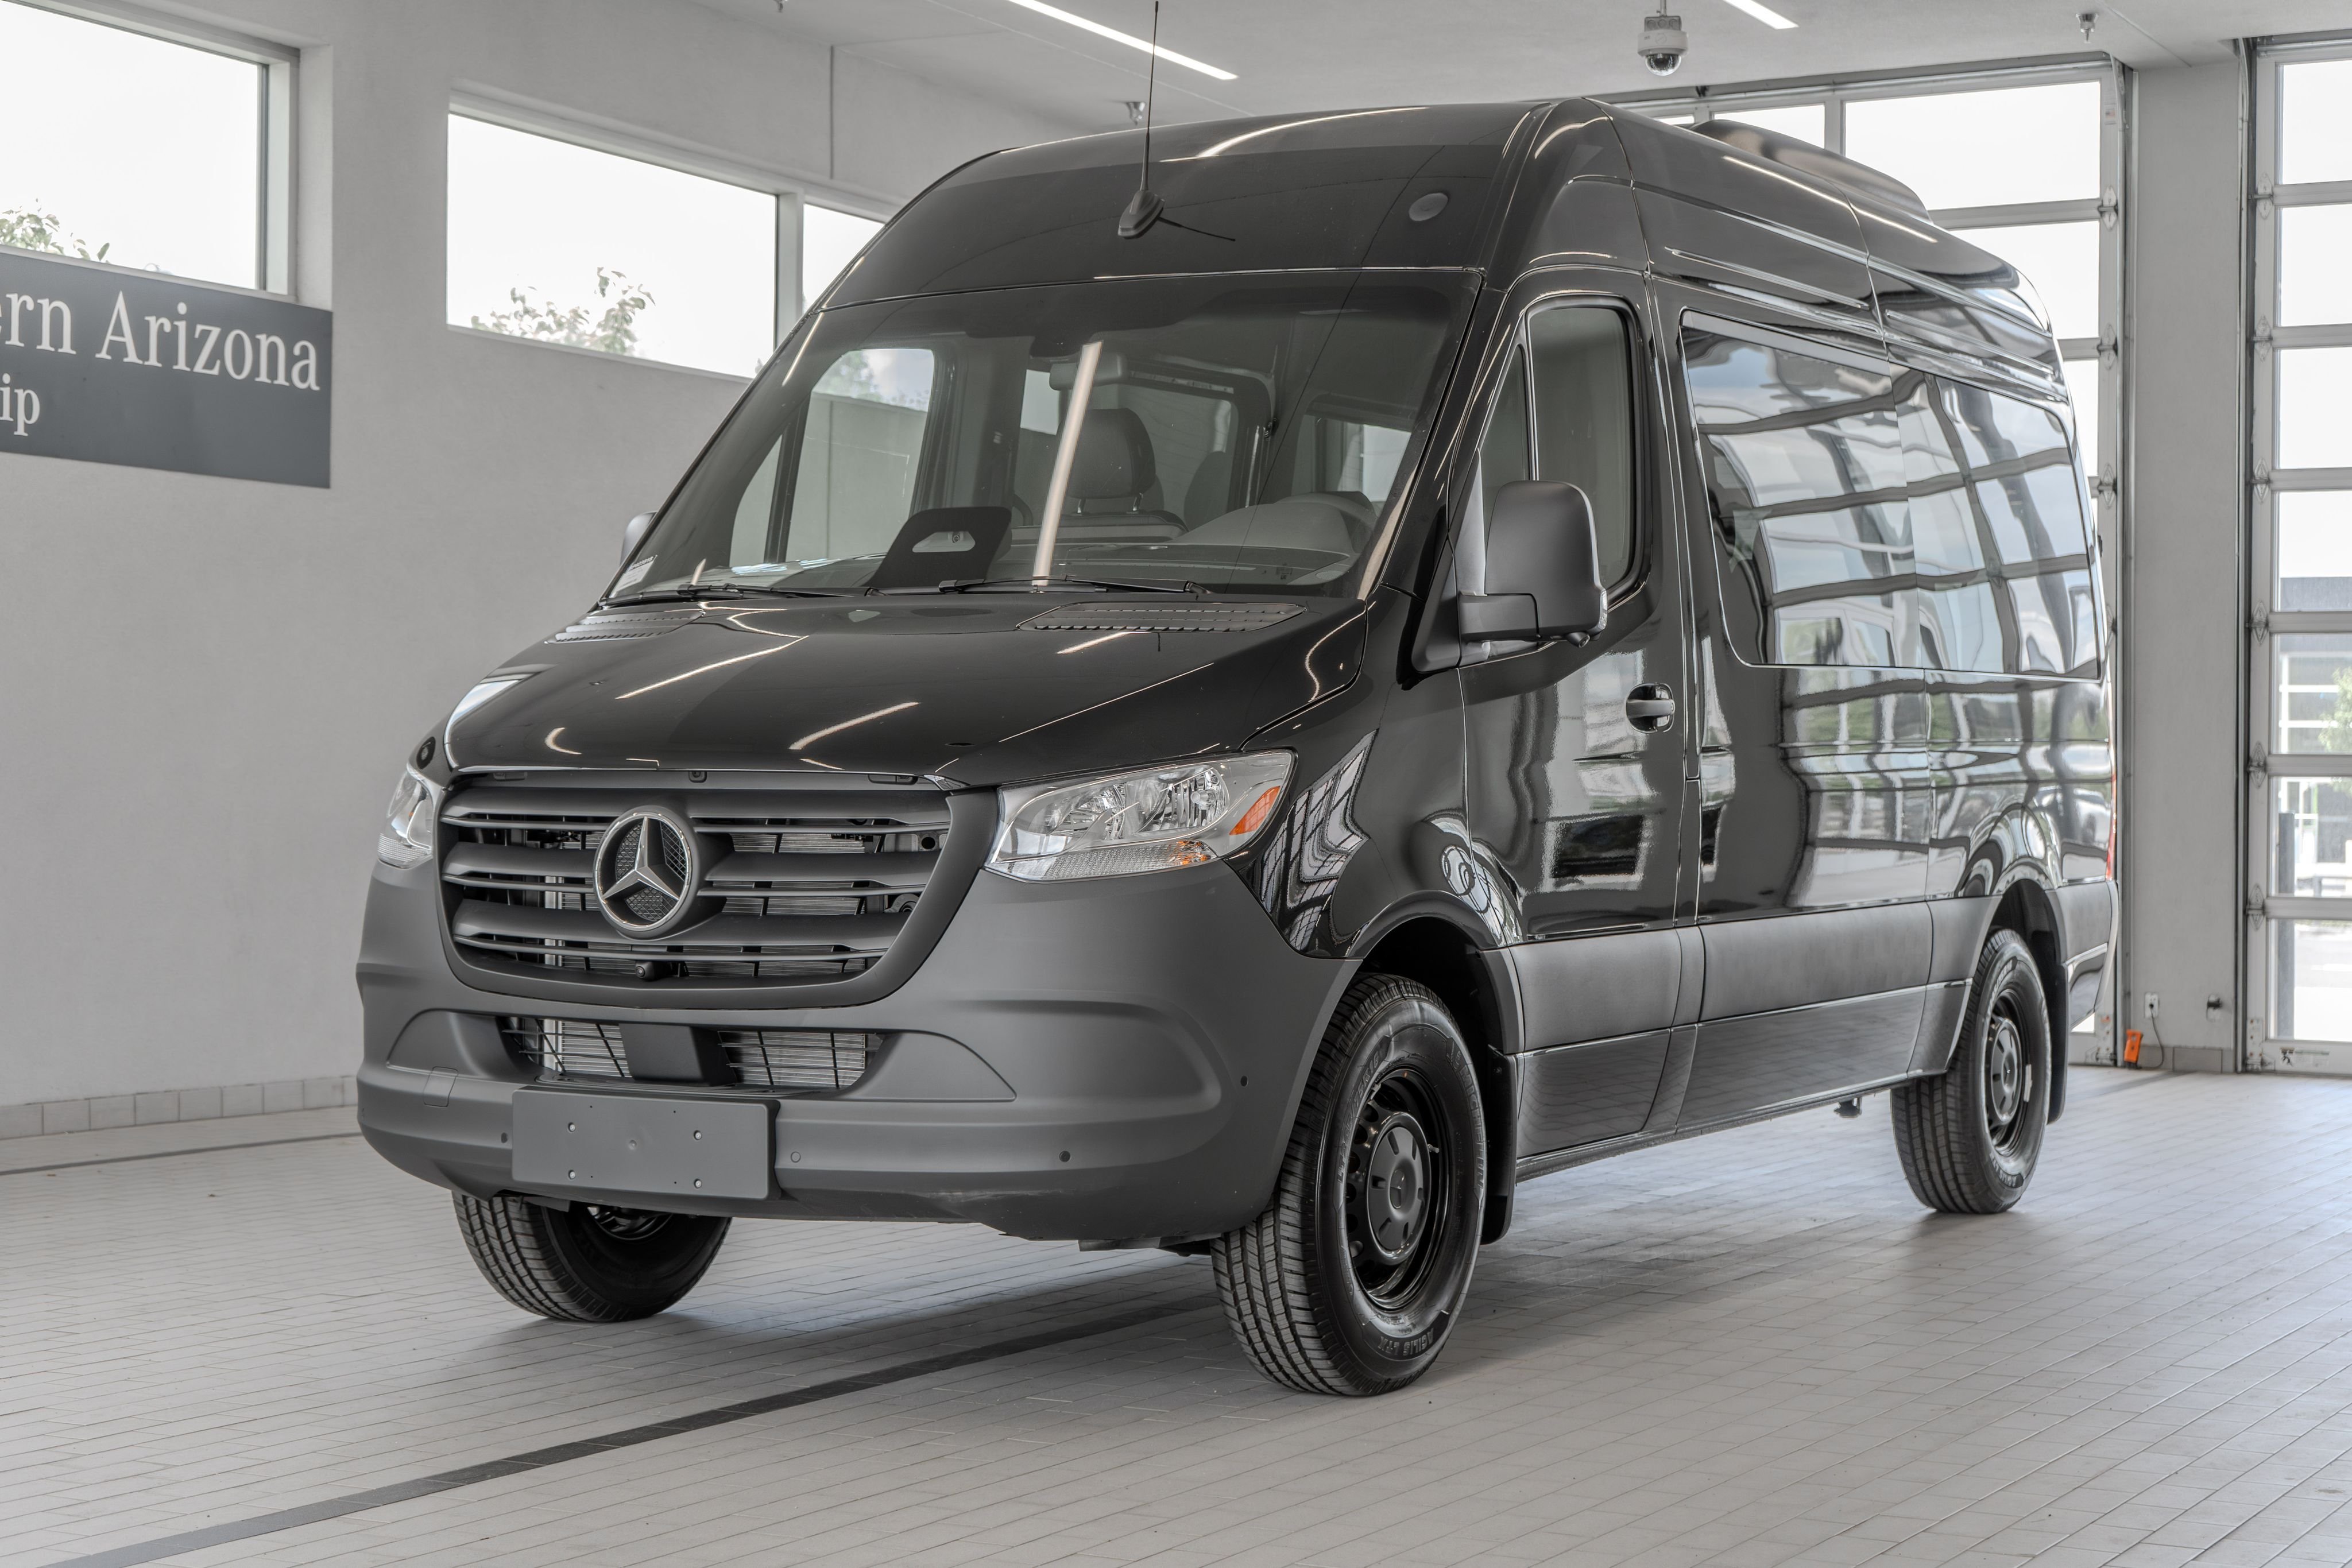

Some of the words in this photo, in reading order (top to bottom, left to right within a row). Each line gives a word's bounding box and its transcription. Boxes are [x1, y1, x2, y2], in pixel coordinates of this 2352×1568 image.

[0, 292, 76, 355] rn
[95, 290, 320, 391] Arizona
[1459, 1064, 1484, 1188] MICHELIN
[1378, 1336, 1400, 1356] LTX
[1403, 1327, 1434, 1356] AGILIS
